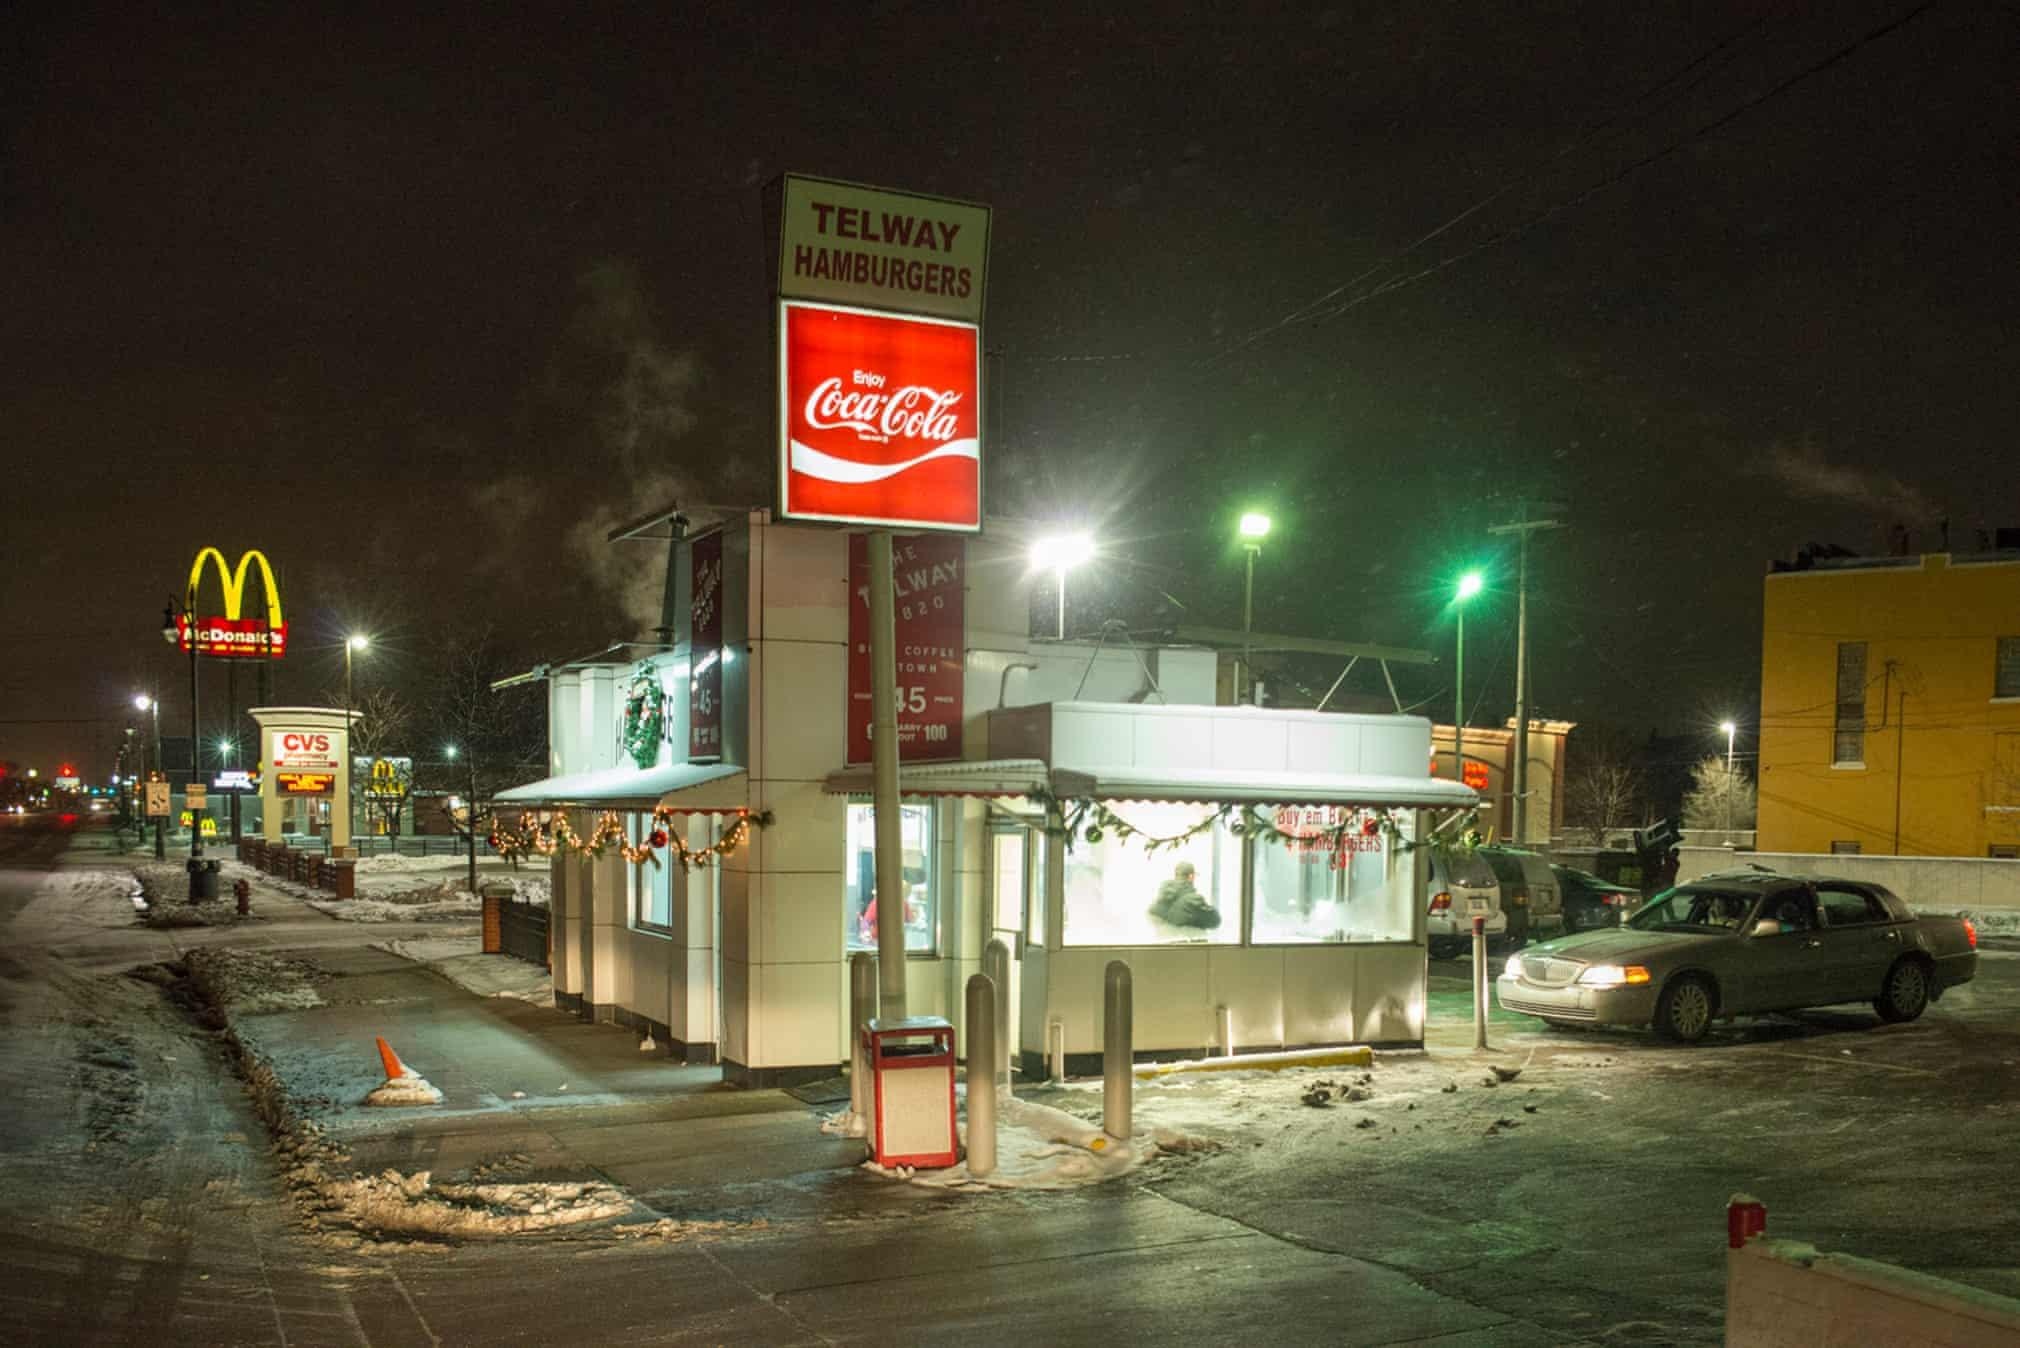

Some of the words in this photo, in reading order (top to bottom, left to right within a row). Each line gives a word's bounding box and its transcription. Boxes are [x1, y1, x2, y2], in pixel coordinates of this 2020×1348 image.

[811, 201, 961, 252] TELWAY
[793, 245, 972, 298] HAMBURGERS
[852, 368, 885, 388] Enjoy
[804, 376, 963, 440] Coca-Cola
[857, 556, 960, 609] TLWAY
[904, 645, 955, 657] COFFEE
[897, 662, 937, 673] TOWN
[924, 724, 948, 741] 100
[283, 734, 330, 752] CVS
